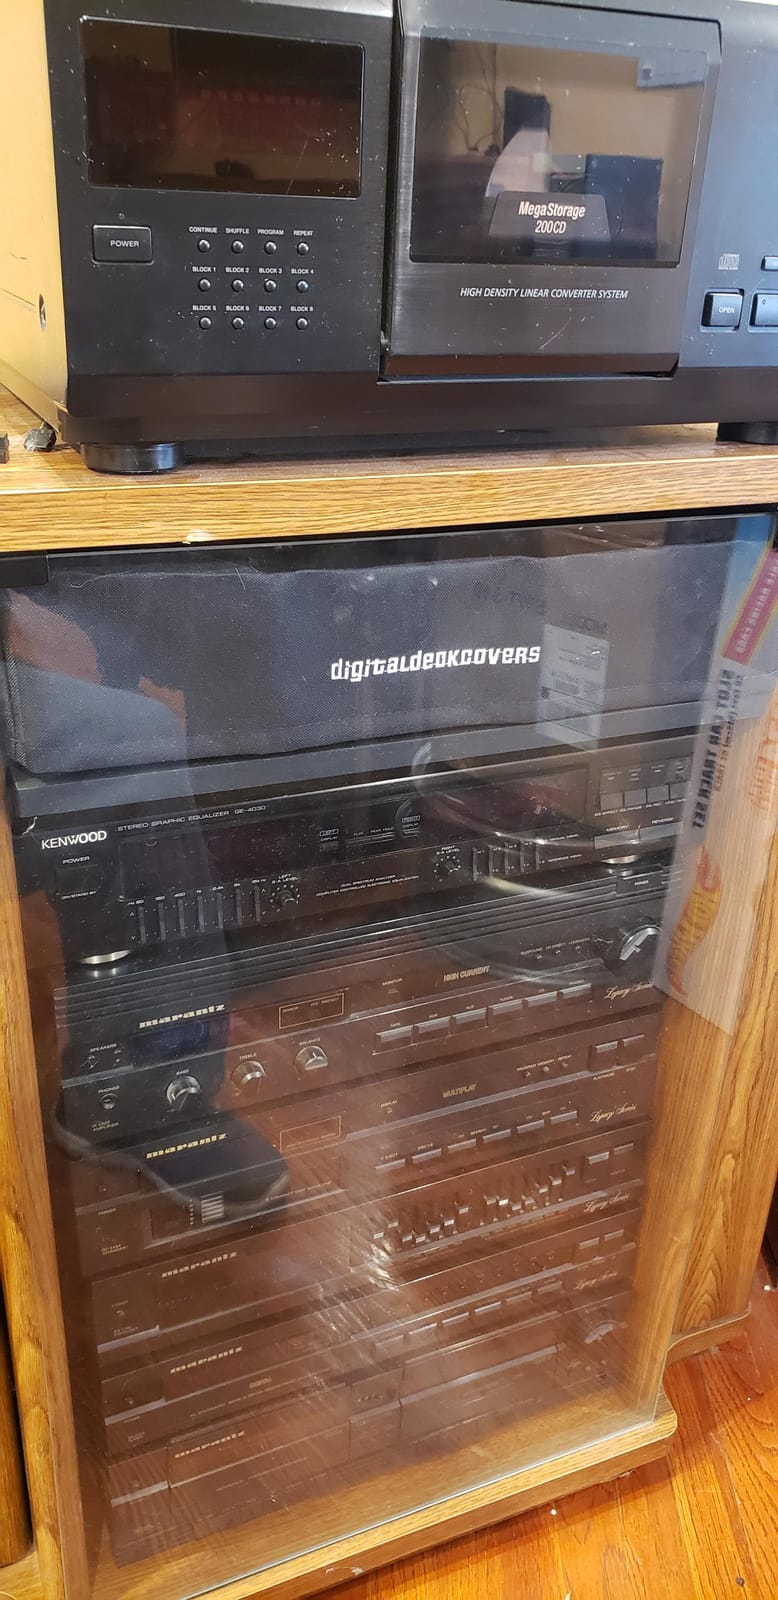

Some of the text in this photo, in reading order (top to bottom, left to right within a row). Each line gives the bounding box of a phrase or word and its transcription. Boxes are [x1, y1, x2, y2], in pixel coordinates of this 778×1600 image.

[225, 227, 250, 235] SHUFFLE
[257, 228, 285, 236] PROGRAM
[535, 221, 566, 234] 200CD
[110, 240, 139, 248] POWER
[460, 287, 628, 299] HIGH DENSITY LINEAR CONVERTER SYSTEM
[719, 306, 735, 314] OPEN
[117, 822, 149, 832] STEREO
[151, 816, 185, 827] GRAPHIC
[188, 810, 230, 822] EQUALIZER
[41, 830, 108, 850] KENWOOD
[62, 856, 90, 865] POWER
[444, 966, 490, 982] HIGH CURRENT
[90, 1043, 117, 1052] SPEAKERS
[442, 1083, 478, 1098] MULTIPLAY
